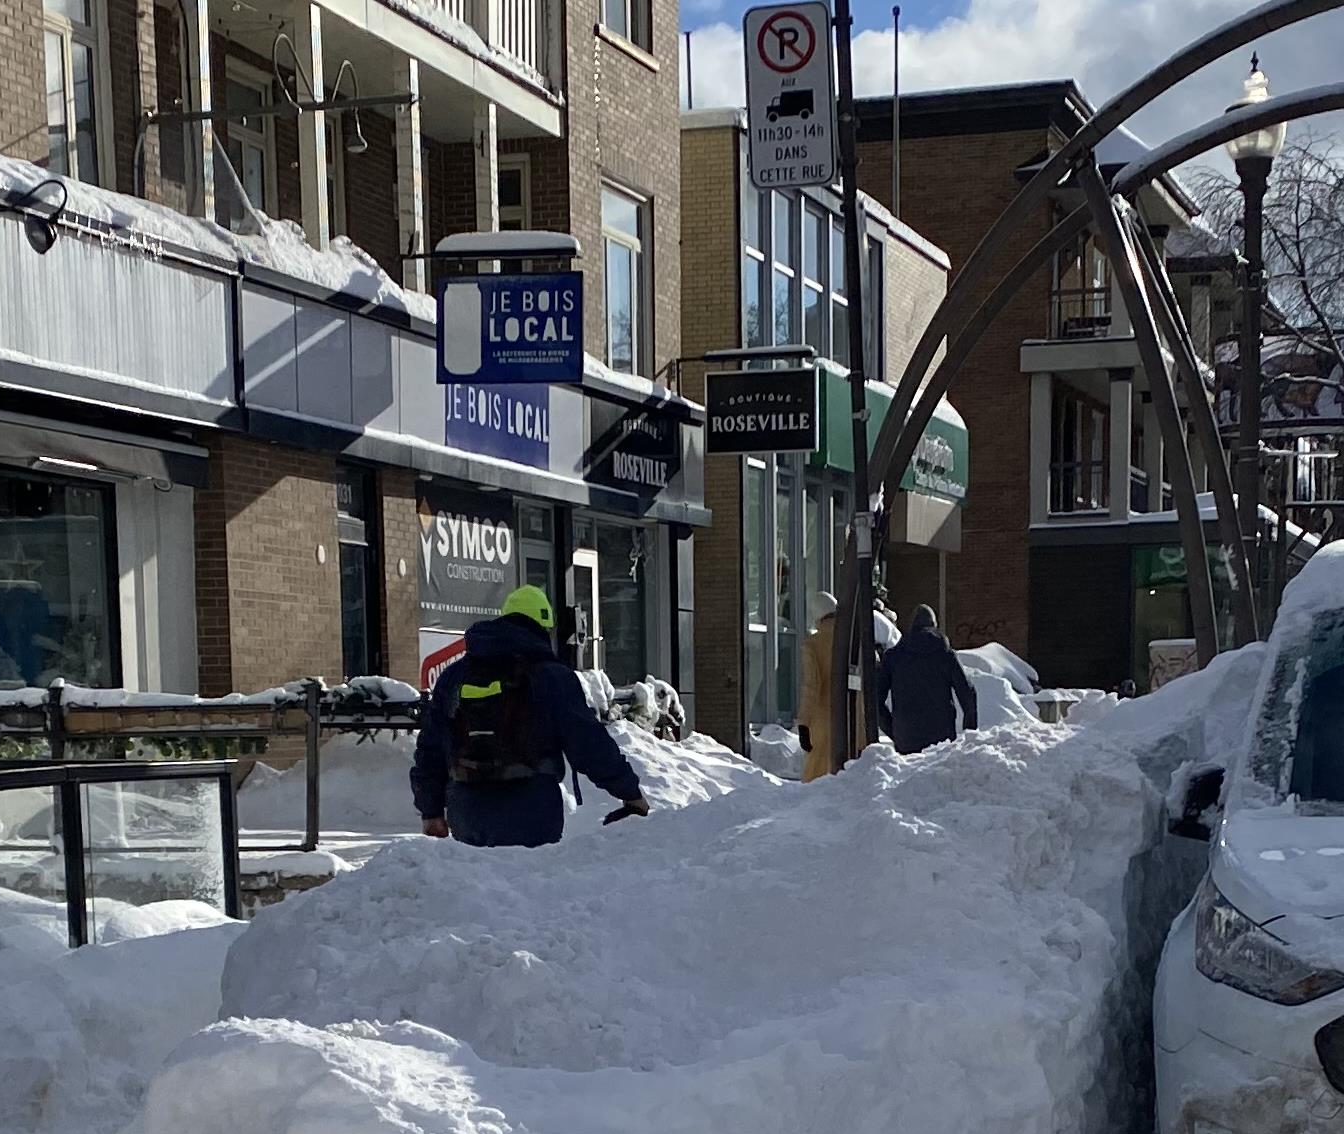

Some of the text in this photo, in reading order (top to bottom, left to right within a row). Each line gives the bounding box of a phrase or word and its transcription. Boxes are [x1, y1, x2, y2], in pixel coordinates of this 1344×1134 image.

[780, 77, 797, 88] AUX
[775, 146, 808, 161] DANS
[759, 164, 826, 183] CETTE RUE
[490, 289, 574, 315] JE BOIS
[489, 315, 574, 342] LOCAL
[447, 384, 549, 443] JE BOIS LOCAL
[711, 412, 810, 433] ROSEVILLE
[613, 450, 669, 489] ROSEVILLE
[436, 509, 512, 565] SYMCO
[446, 562, 505, 583] CONSTRUCTION
